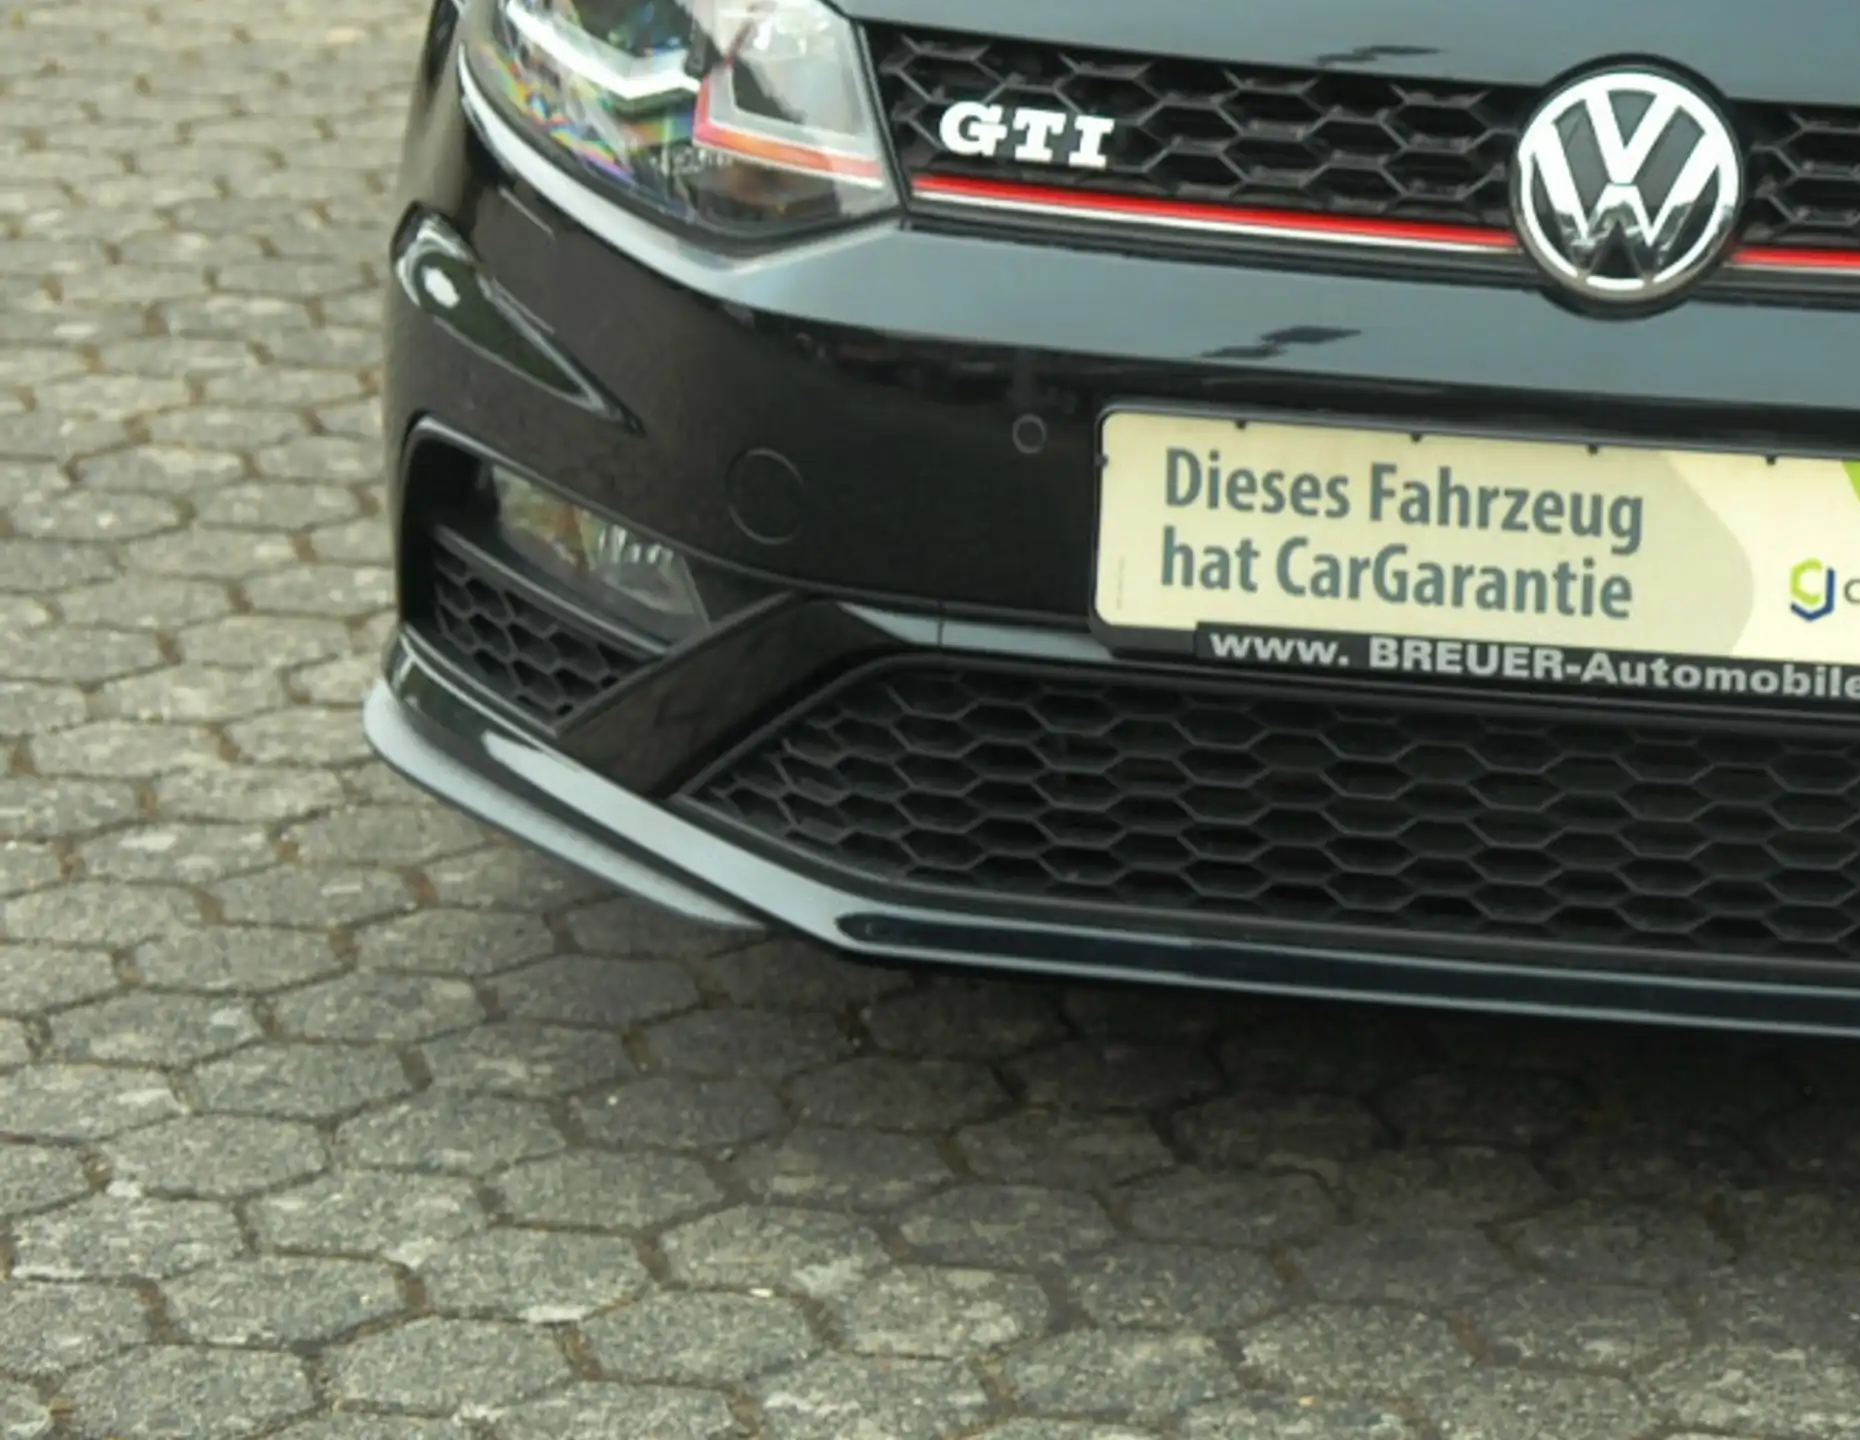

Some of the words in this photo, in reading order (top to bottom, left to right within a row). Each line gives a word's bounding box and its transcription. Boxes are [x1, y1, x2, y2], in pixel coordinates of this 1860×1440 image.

[939, 100, 1115, 168] GTI
[1166, 447, 1351, 519] Dieses
[1369, 461, 1643, 556] Fahrzeug
[1161, 525, 1260, 593] hat
[1275, 535, 1633, 620] CarGarantie
[1210, 632, 1349, 666] www.
